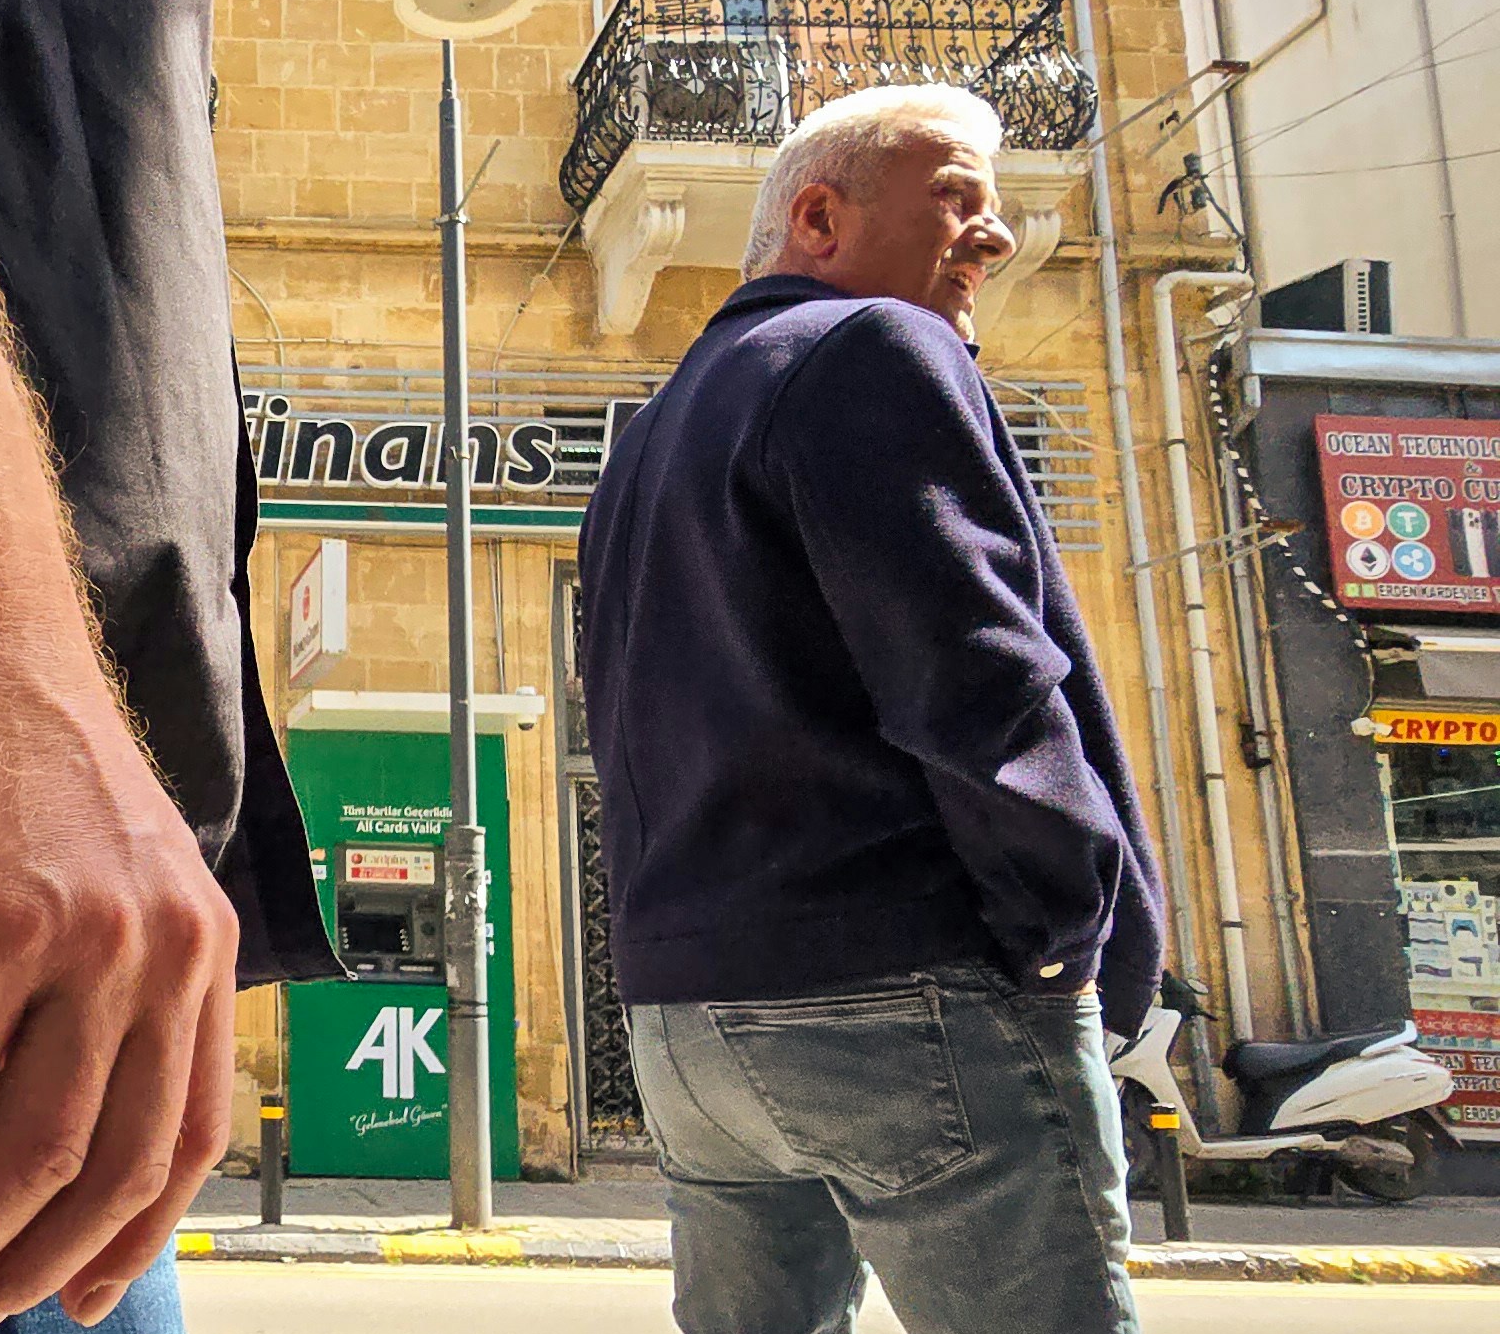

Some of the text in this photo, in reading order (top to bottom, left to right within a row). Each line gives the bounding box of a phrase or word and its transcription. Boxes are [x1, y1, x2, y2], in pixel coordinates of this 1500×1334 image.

[1327, 433, 1392, 456] OCEAN
[1340, 475, 1456, 501] CRYPTO
[1389, 718, 1498, 742] CRYPTO
[342, 805, 365, 816] Tüm
[367, 805, 402, 817] Kartlar
[356, 820, 442, 835] All Cards Valid
[345, 1006, 447, 1099] AK
